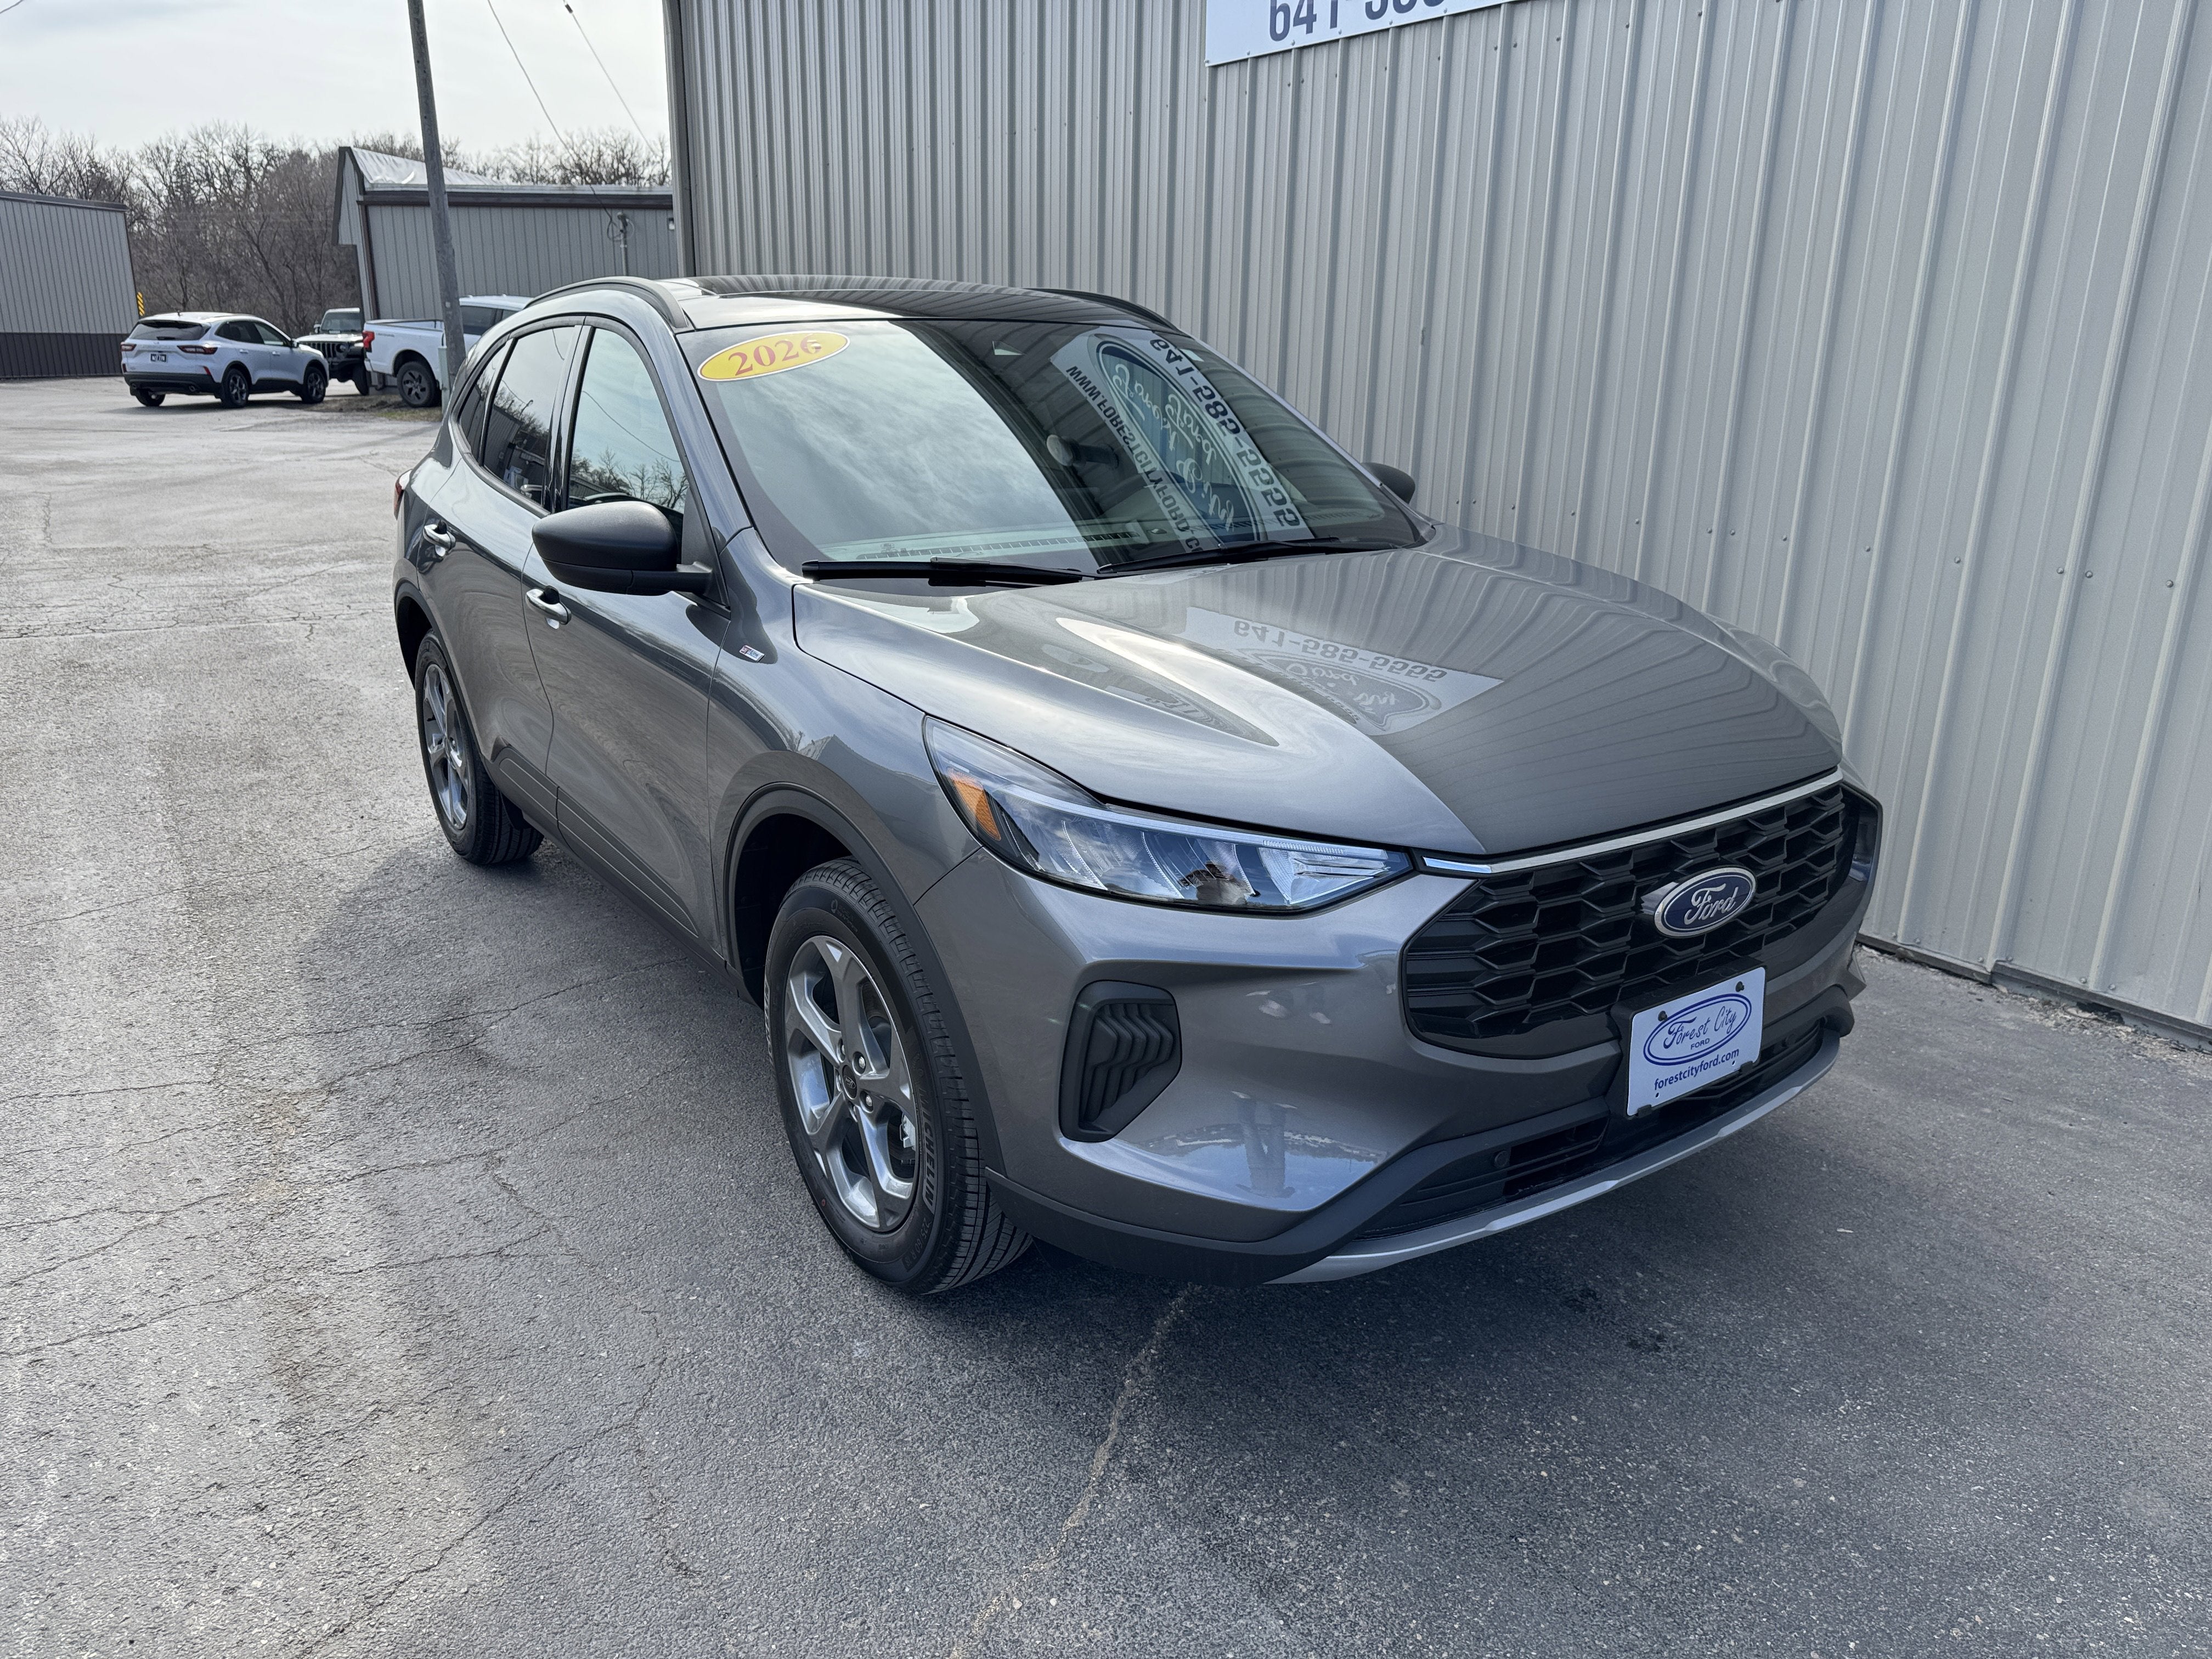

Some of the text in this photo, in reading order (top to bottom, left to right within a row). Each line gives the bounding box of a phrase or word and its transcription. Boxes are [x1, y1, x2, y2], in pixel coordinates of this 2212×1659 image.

[728, 333, 822, 376] 2026
[1684, 883, 1737, 925] Ford
[1663, 1006, 1737, 1049] Forest City
[1690, 1038, 1710, 1050] FORD
[1654, 1047, 1740, 1091] forestcityford.com
